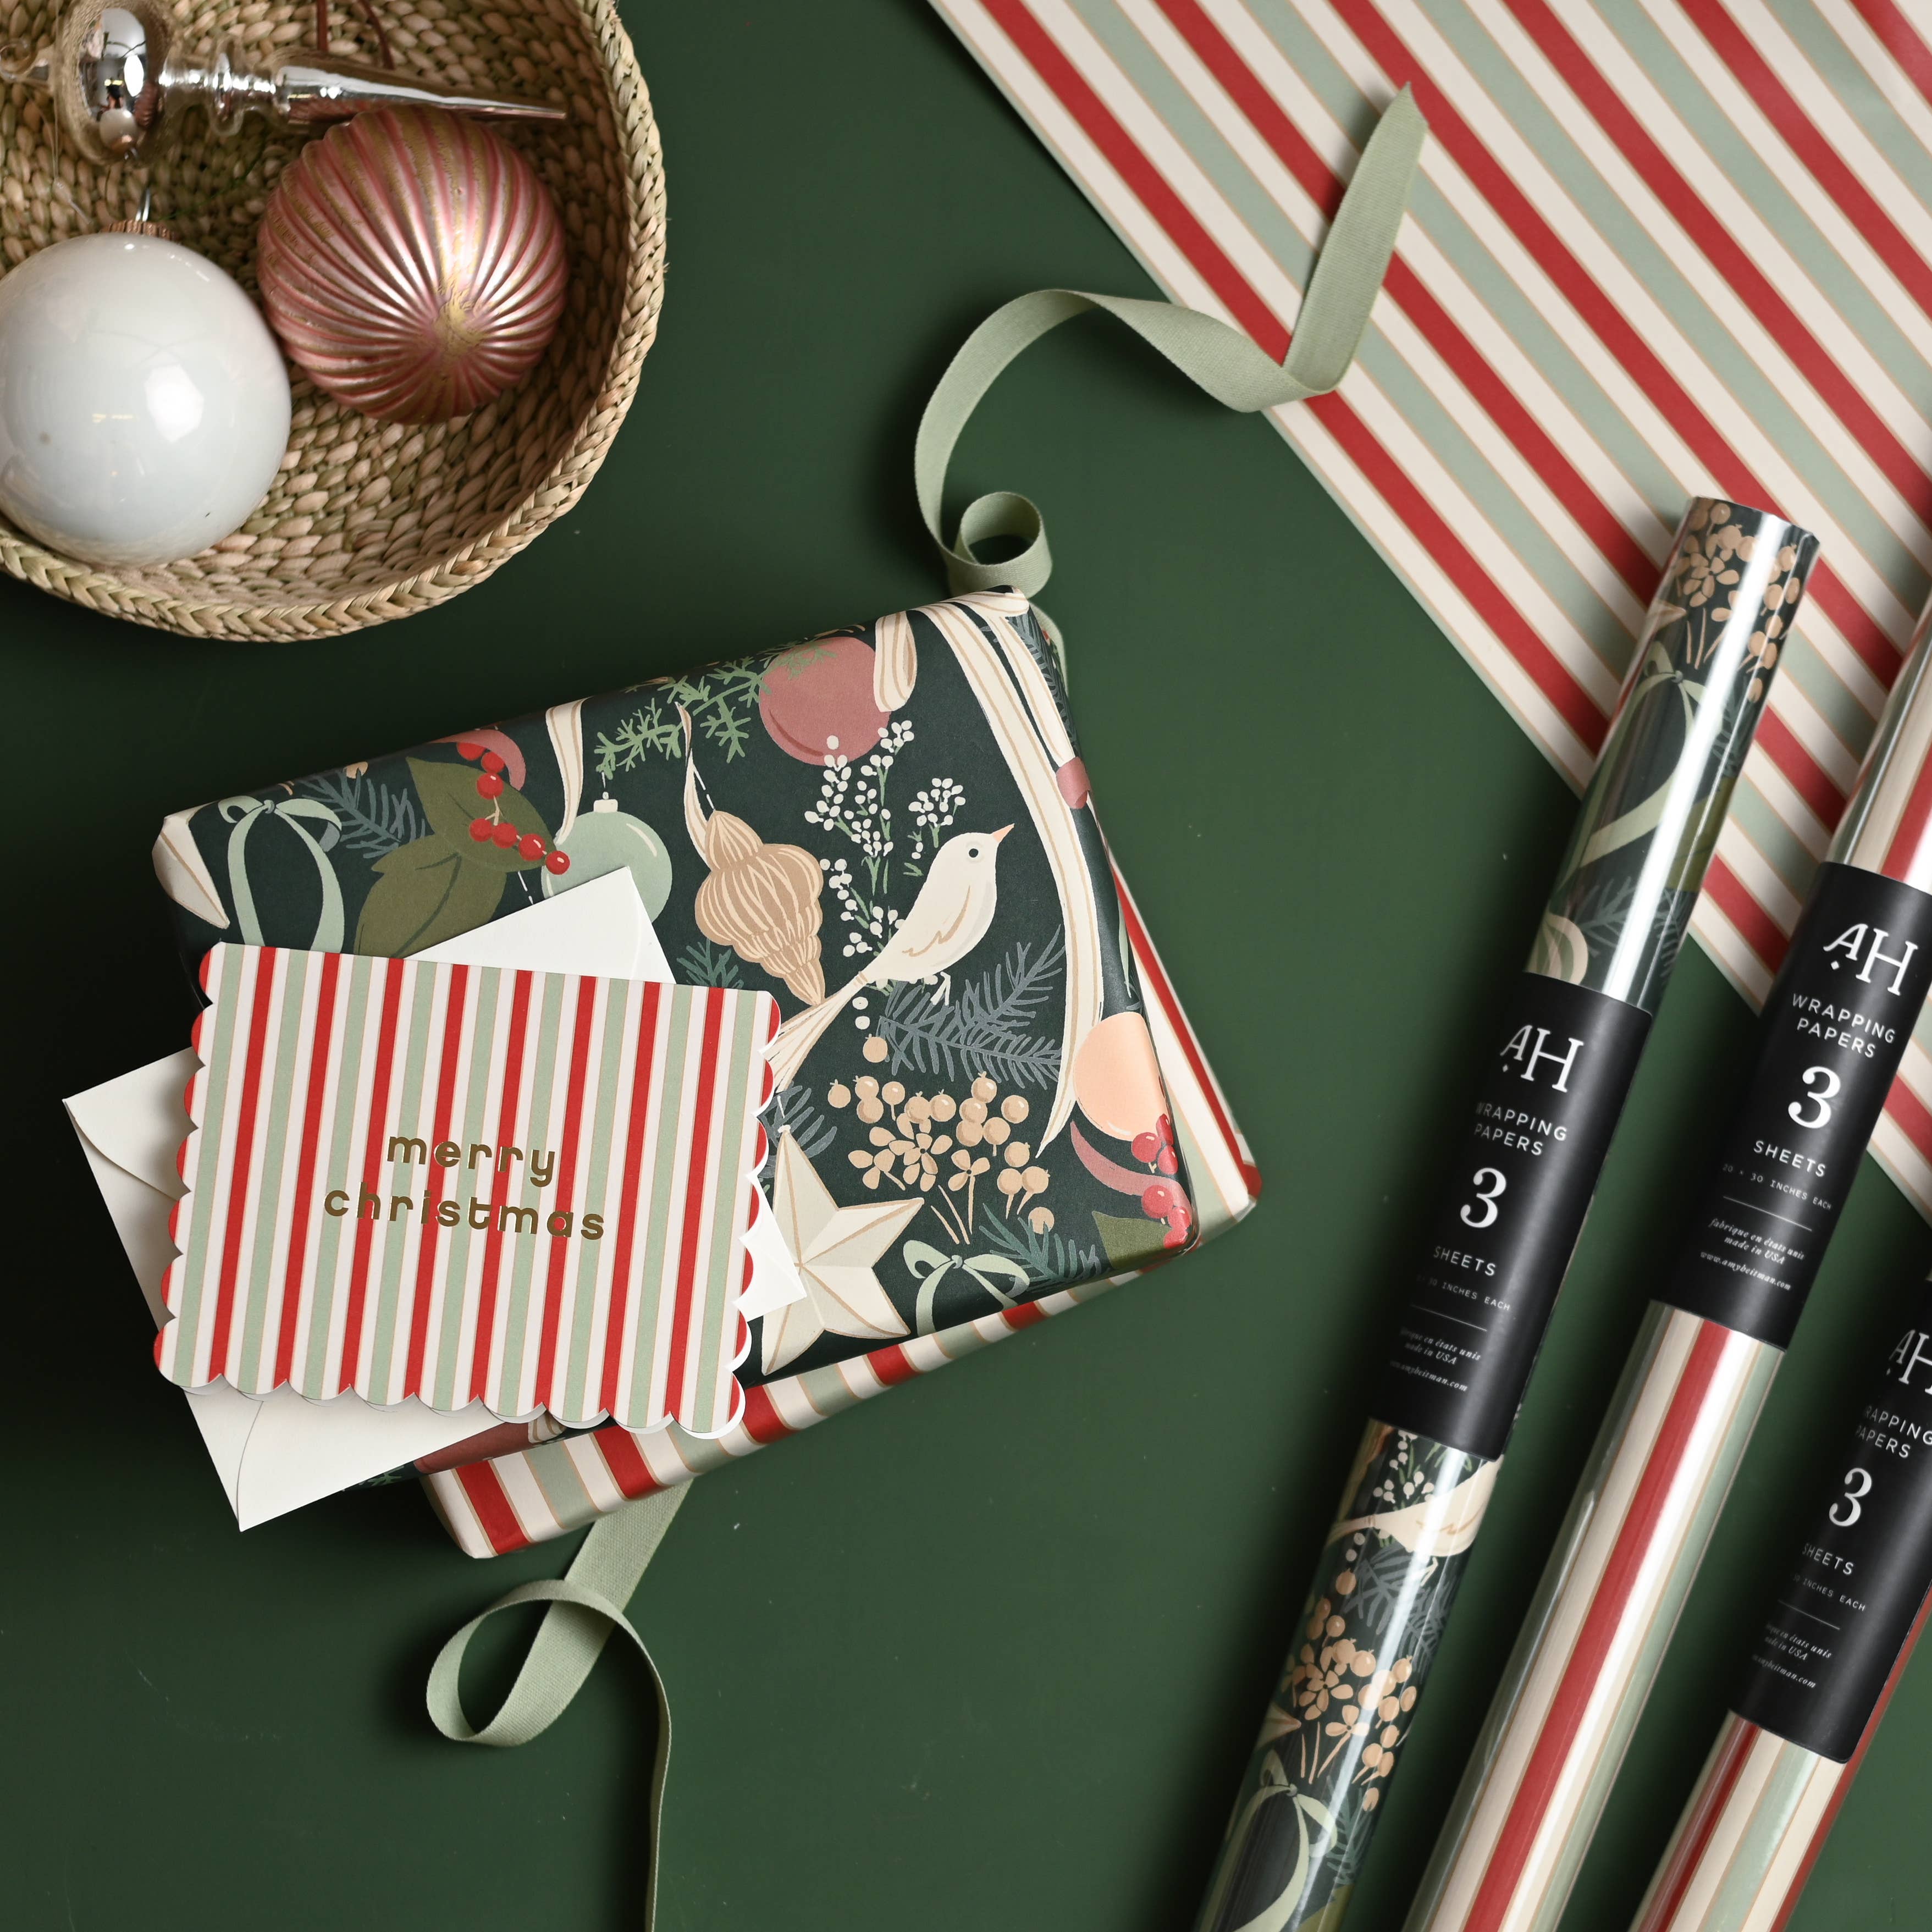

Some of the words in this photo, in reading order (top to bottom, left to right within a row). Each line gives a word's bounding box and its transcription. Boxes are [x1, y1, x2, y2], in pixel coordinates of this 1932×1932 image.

[1823, 924, 1918, 996] AH
[1792, 993, 1896, 1044] WRAPPING
[1797, 1018, 1876, 1058] PAPERS
[1500, 1024, 1584, 1092] AH
[1788, 1066, 1841, 1129] 3
[1474, 1123, 1543, 1155] PAPERS
[387, 1135, 556, 1188] merry
[1753, 1140, 1826, 1177] SHEETS
[1460, 1168, 1506, 1228] 3
[1751, 1173, 1763, 1183] 30
[1770, 1179, 1808, 1200] INCHES
[1812, 1196, 1832, 1210] EACH
[324, 1181, 604, 1240] christmas
[1708, 1218, 1749, 1238] fabrique
[1751, 1233, 1761, 1243] en
[1787, 1247, 1805, 1260] unis
[1724, 1237, 1749, 1250] made
[1751, 1244, 1762, 1255] in
[1764, 1249, 1786, 1265] USA
[1433, 1246, 1496, 1276] SHEETS
[1442, 1282, 1478, 1300] INCHES
[1484, 1296, 1510, 1311] EACH
[1423, 1346, 1433, 1356] in
[1436, 1351, 1458, 1365] USA
[1459, 1348, 1481, 1361] unis
[1829, 1467, 1872, 1527] 3
[1802, 1542, 1854, 1575] SHEETS
[1803, 1578, 1834, 1597] INCHES
[1839, 1594, 1865, 1611] EACH
[1778, 1641, 1787, 1651] in
[1788, 1646, 1809, 1661] USA
[1810, 1645, 1832, 1659] unis
